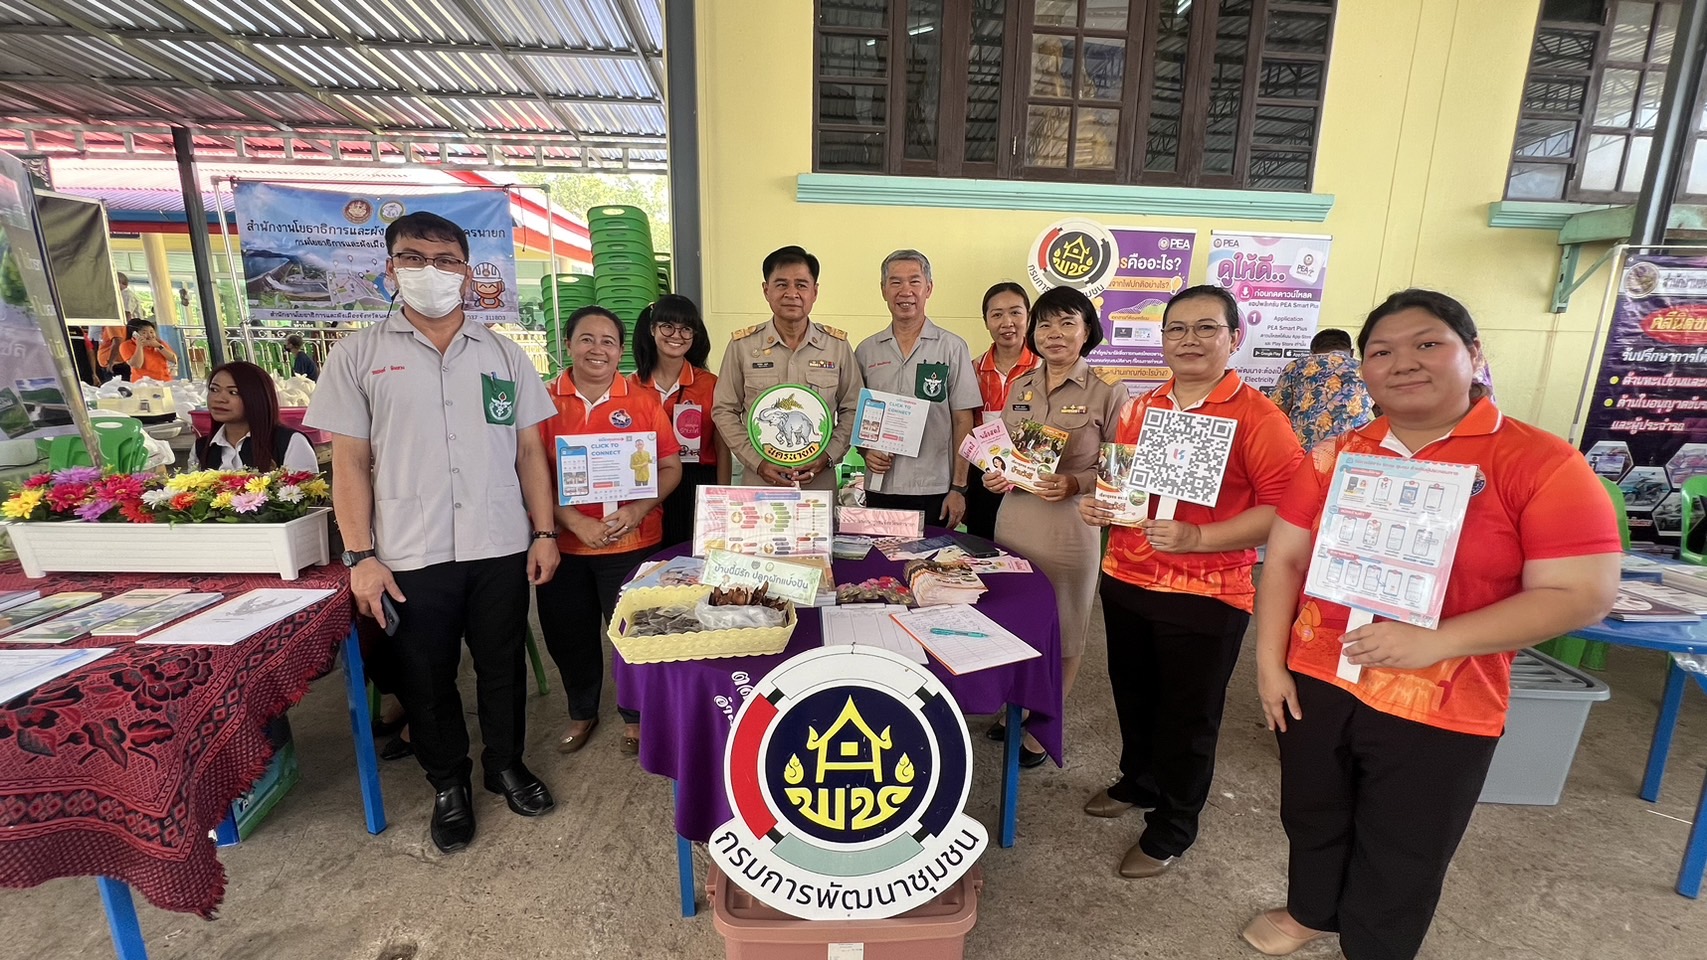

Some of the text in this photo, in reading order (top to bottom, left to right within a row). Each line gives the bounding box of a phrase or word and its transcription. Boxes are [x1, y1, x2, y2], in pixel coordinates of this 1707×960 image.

[1170, 238, 1191, 250] PEA
[1223, 239, 1240, 248] PEA
[1244, 376, 1275, 384] Electricity
[590, 449, 621, 457] CONNECT
[714, 828, 980, 910] กรมการพัฒนาชุมชน
